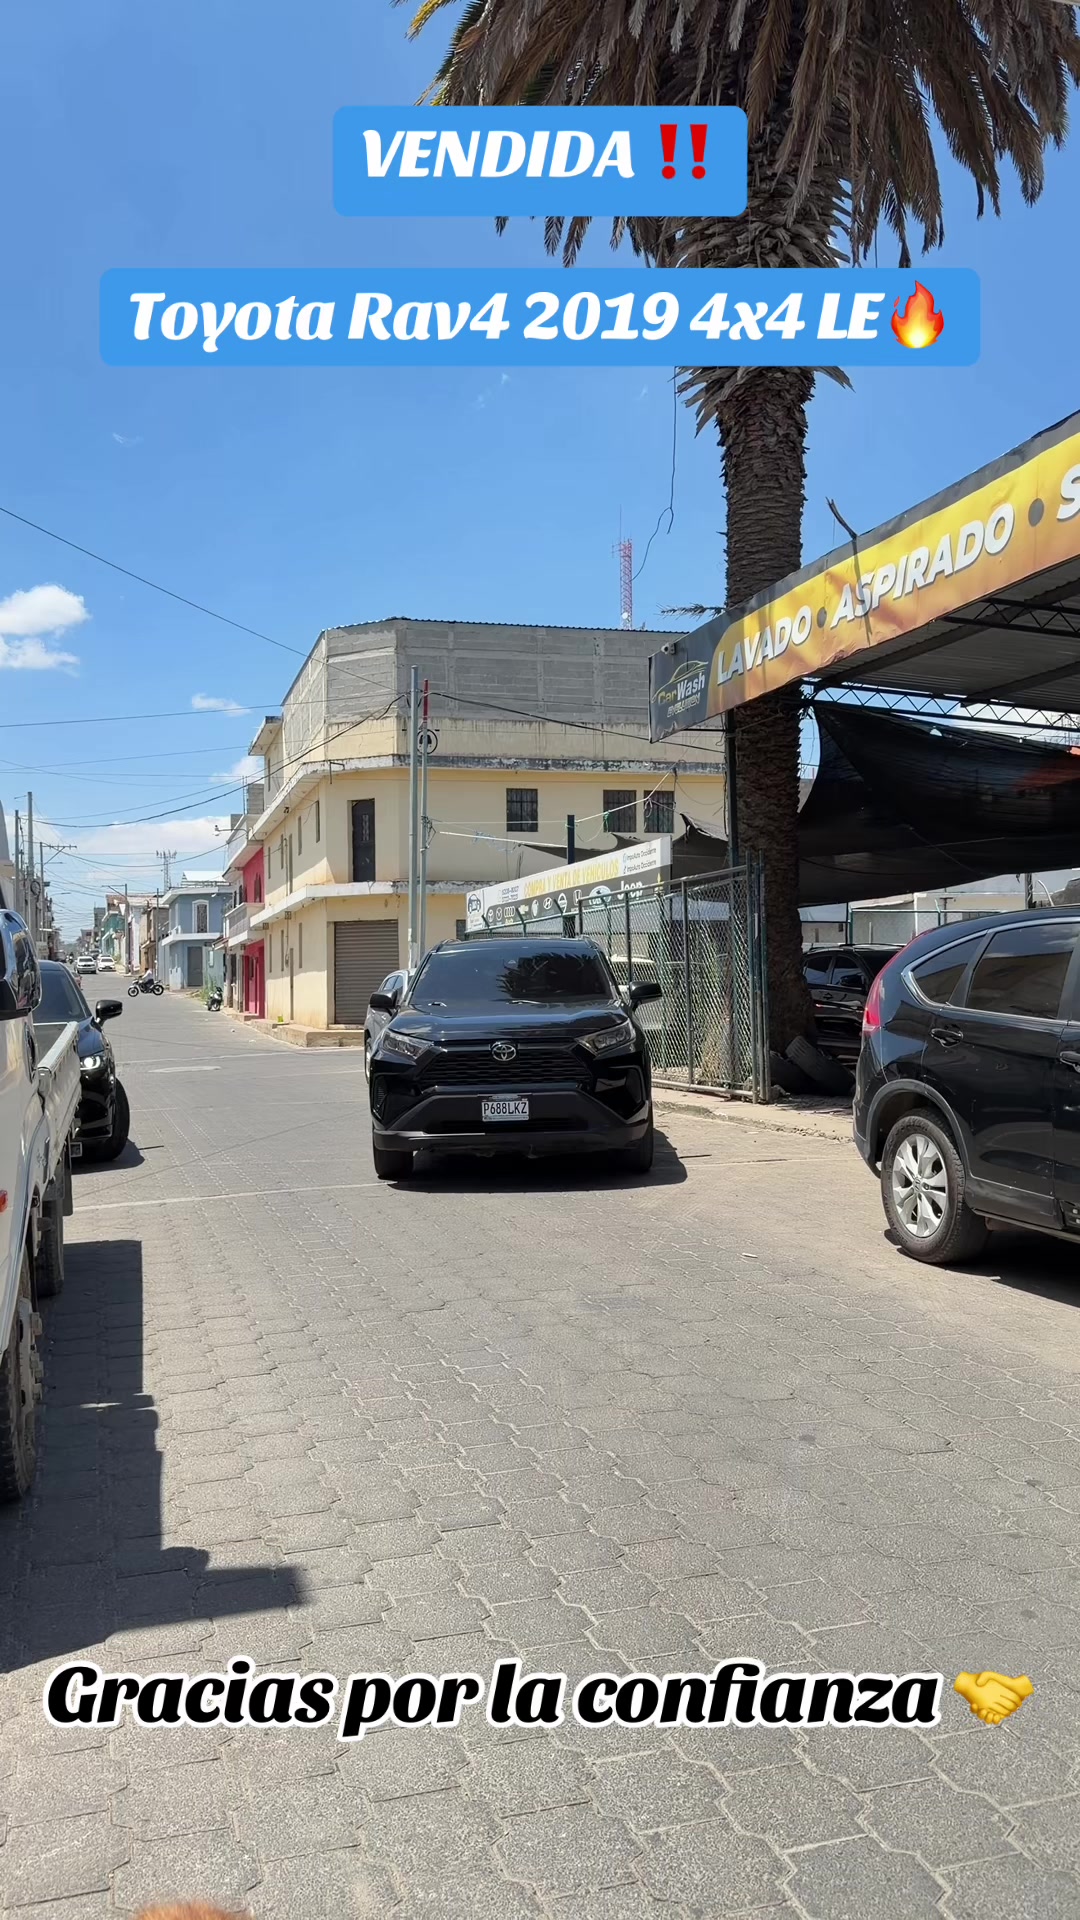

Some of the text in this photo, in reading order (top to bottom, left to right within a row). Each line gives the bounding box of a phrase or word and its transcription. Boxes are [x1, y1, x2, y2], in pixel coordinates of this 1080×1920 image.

[716, 606, 813, 686] LAVADO
[830, 503, 1015, 628] ASPIRADO
[523, 878, 545, 899] COMPRA
[546, 874, 553, 892] Y
[553, 870, 572, 890] VENTA
[573, 867, 581, 886] DE
[483, 1102, 528, 1115] P688LKZ
